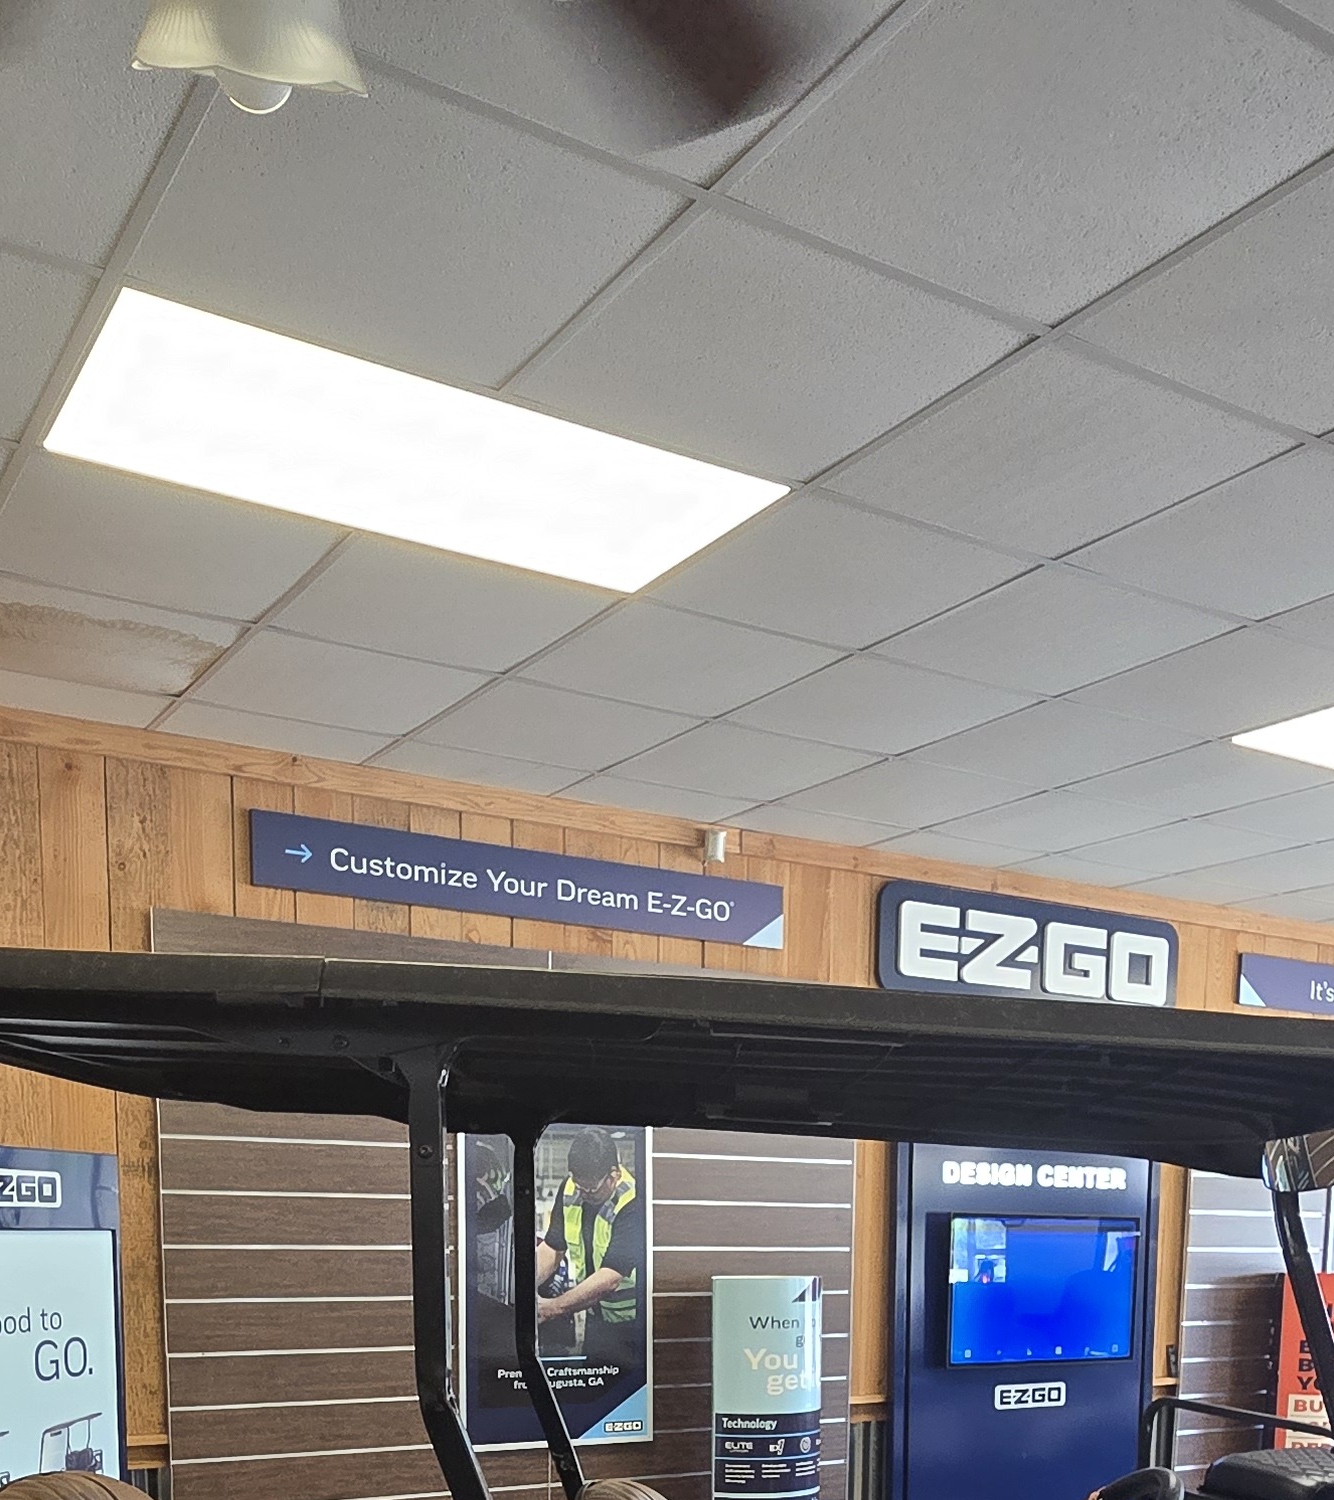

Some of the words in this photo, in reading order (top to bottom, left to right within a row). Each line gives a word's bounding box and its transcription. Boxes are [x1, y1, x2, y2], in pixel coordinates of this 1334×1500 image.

[329, 847, 478, 890] Customize
[486, 868, 548, 899] Your
[557, 878, 639, 911] Dream
[1309, 979, 1334, 1003] It's
[942, 1160, 1033, 1187] DESIGN
[1037, 1164, 1127, 1190] CENTER
[40, 1308, 63, 1332] to
[749, 1315, 800, 1330] When
[33, 1336, 94, 1381] GO.
[743, 1347, 798, 1371] You
[547, 1365, 620, 1377] Craftsmanship
[549, 1378, 586, 1389] ugusta,
[588, 1376, 604, 1386] GA
[722, 1417, 777, 1431] Technology
